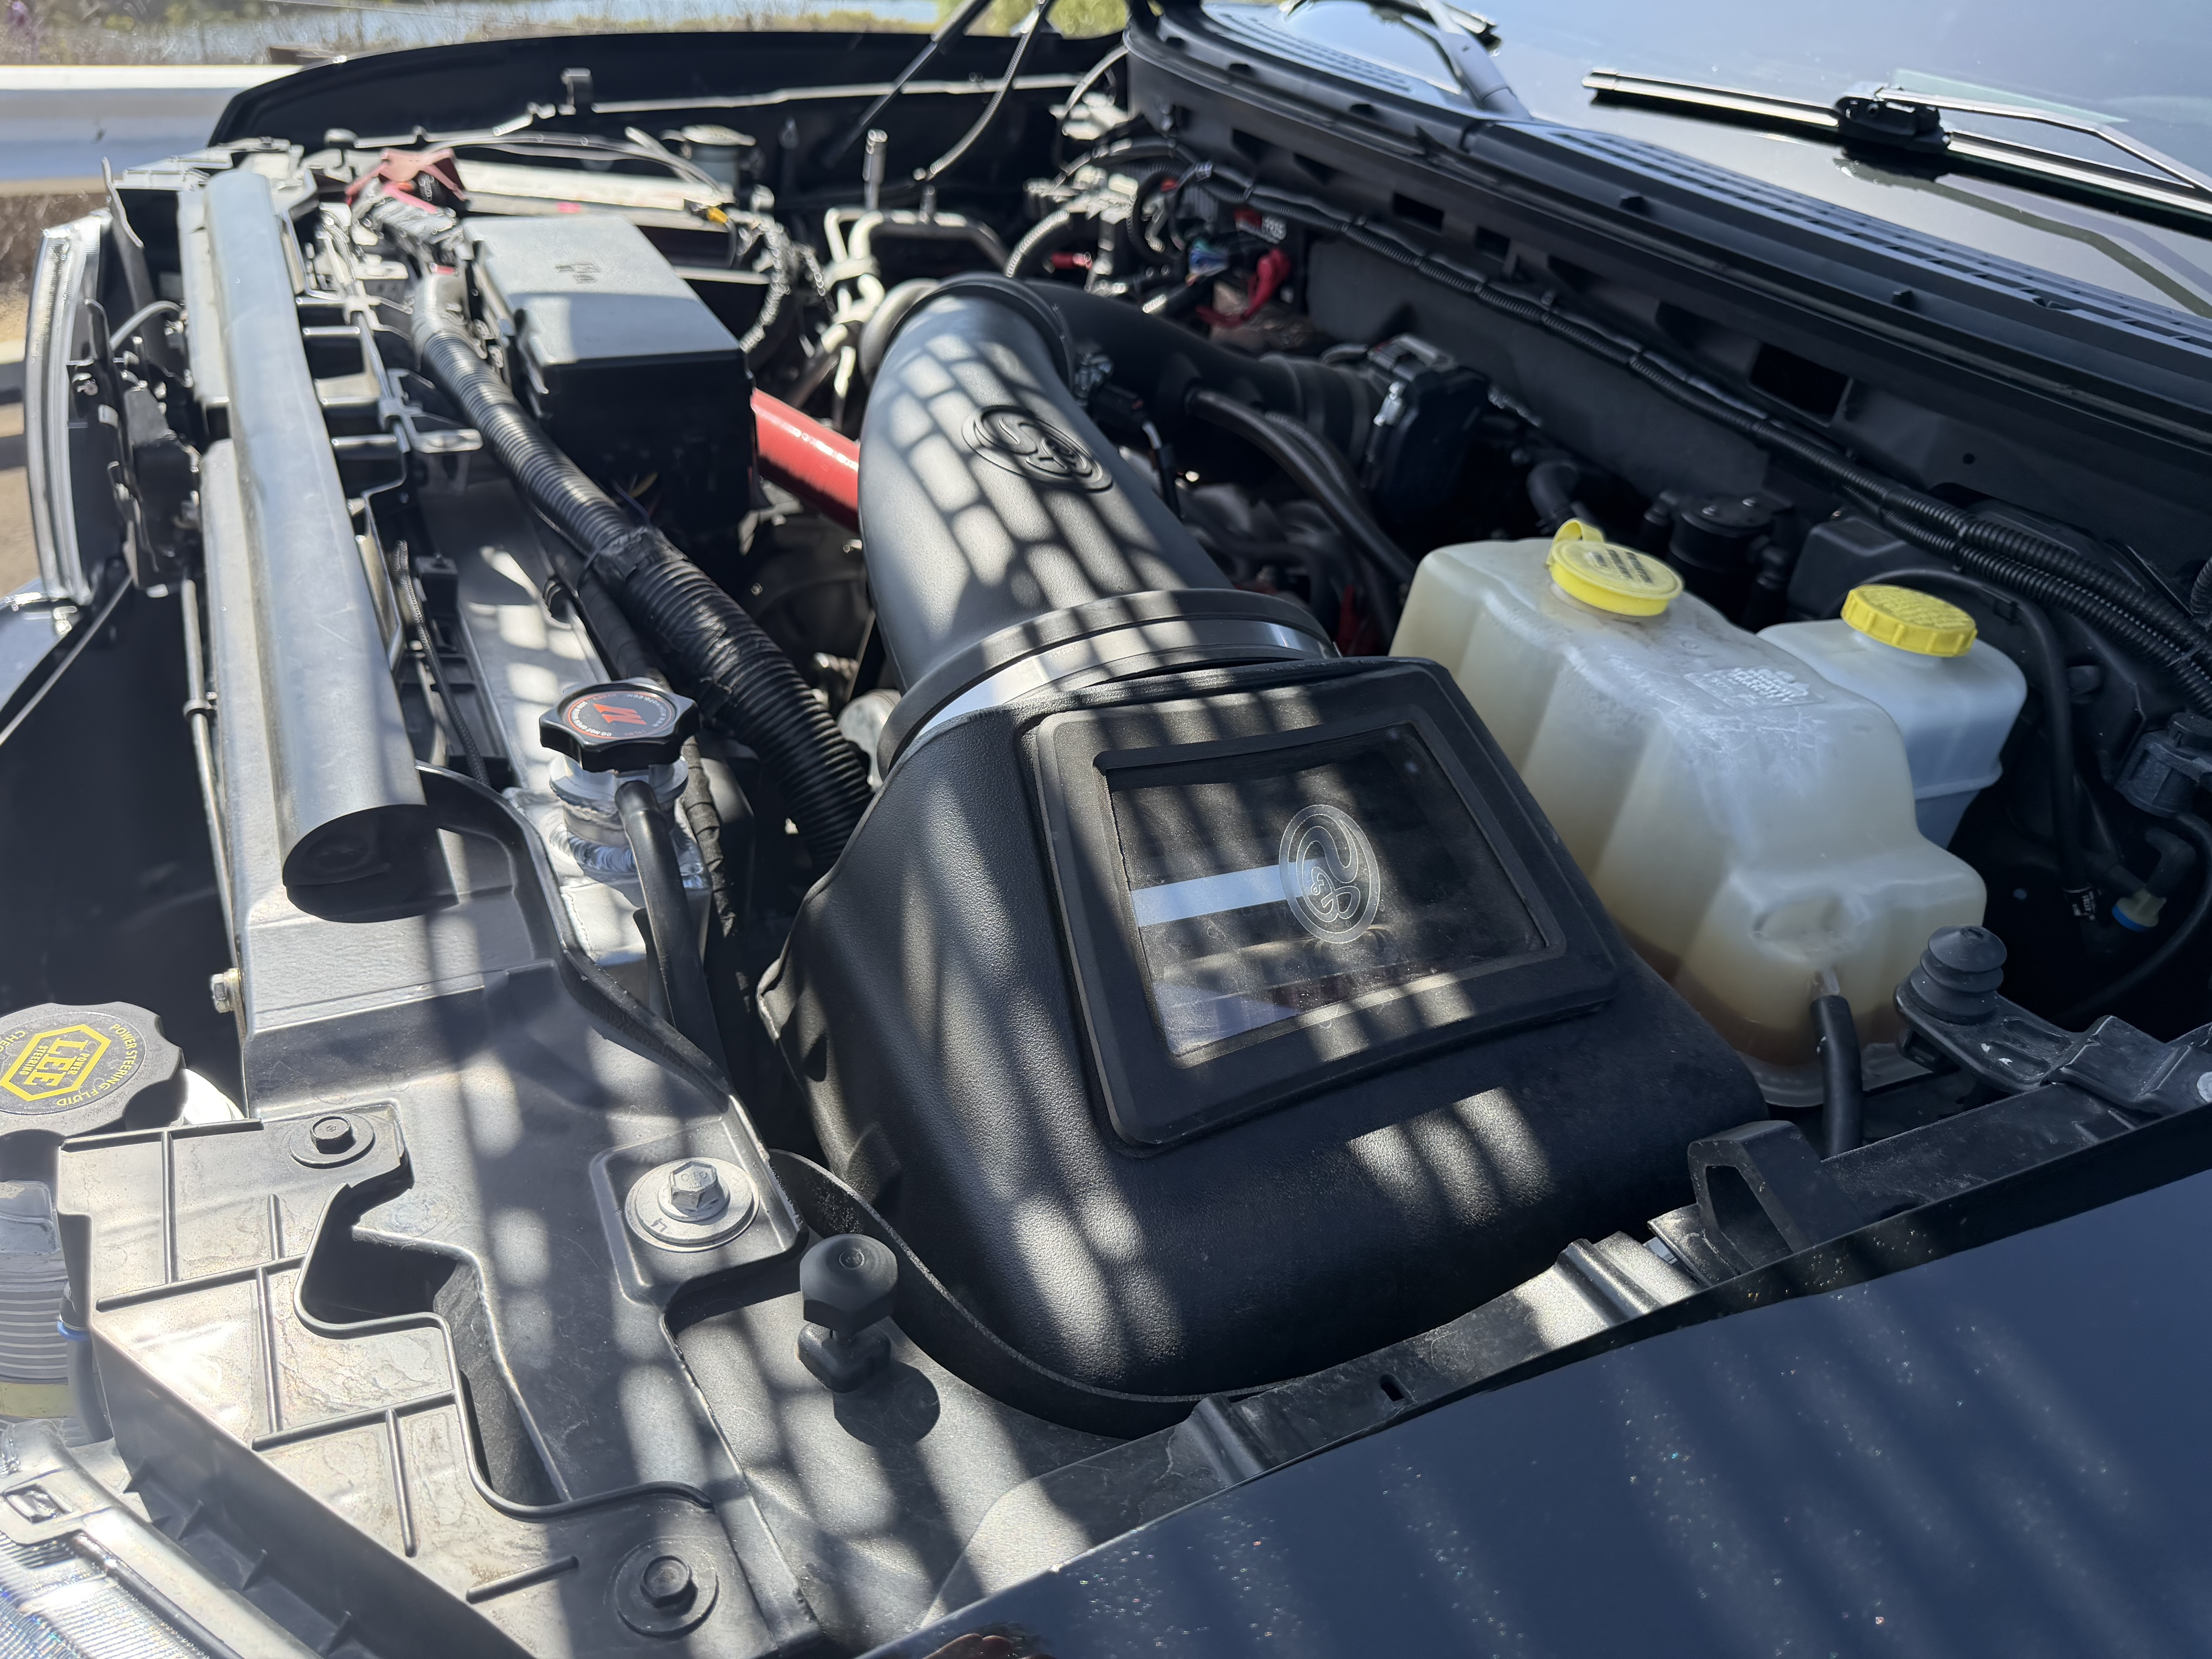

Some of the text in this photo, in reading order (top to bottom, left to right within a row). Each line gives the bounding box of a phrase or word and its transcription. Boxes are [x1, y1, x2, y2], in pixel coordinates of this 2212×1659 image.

[19, 1045, 49, 1075] STEERING
[24, 1037, 89, 1086] LEE
[57, 1024, 137, 1106] POWER STEERING FLUID
[67, 1053, 91, 1075] POWER
